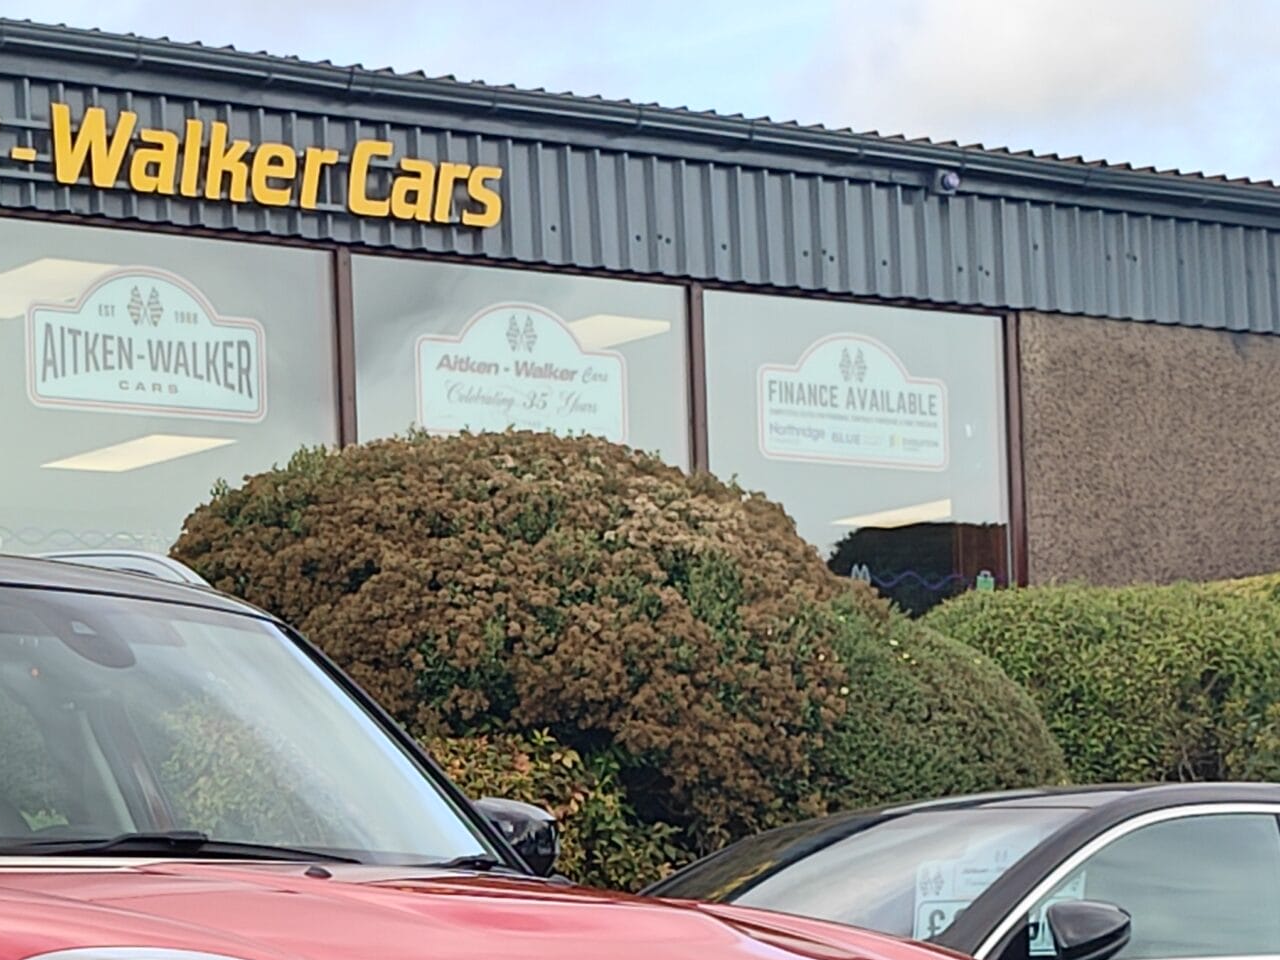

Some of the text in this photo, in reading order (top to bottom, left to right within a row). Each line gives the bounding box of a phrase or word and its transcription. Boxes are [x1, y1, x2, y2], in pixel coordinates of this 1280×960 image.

[50, 102, 339, 210] Walker
[348, 138, 503, 228] Cars
[98, 303, 115, 318] EST
[41, 321, 254, 400] AITKEN-WALKER
[436, 353, 500, 376] Aitken
[514, 360, 579, 382] Walker
[118, 379, 180, 395] CARS
[522, 389, 548, 412] 35
[768, 379, 938, 417] FINANCE AVAILABLE
